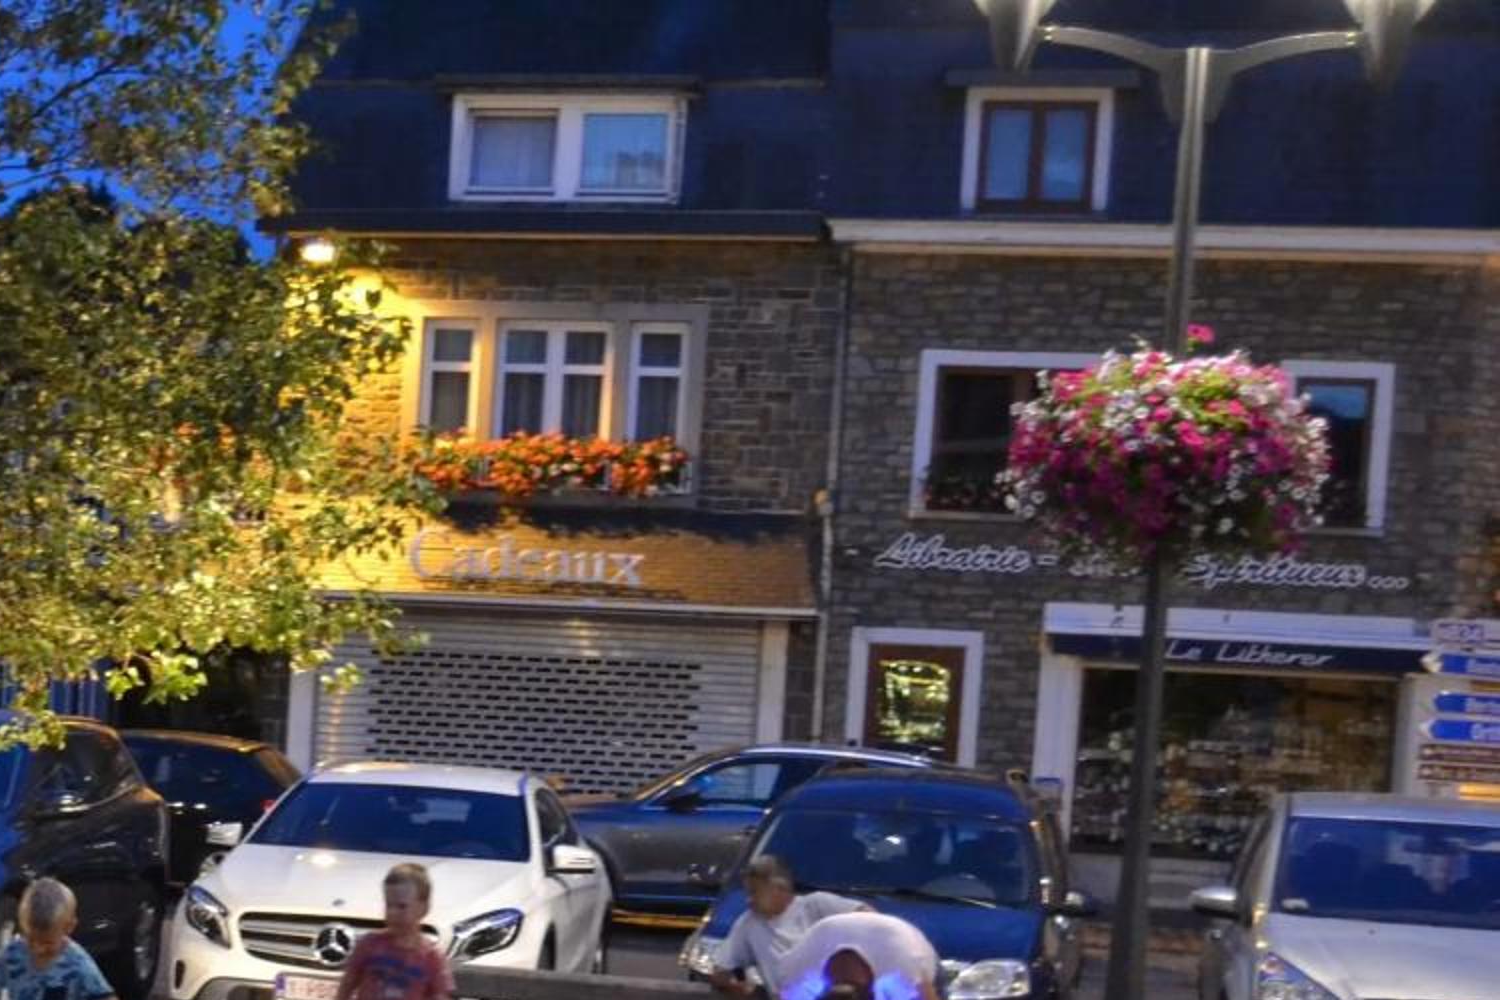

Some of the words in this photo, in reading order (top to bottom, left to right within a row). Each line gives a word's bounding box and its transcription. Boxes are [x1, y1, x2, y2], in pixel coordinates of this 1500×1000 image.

[408, 525, 646, 588] Cadeaux
[873, 532, 1033, 574] Librairie
[1163, 638, 1204, 662] Le
